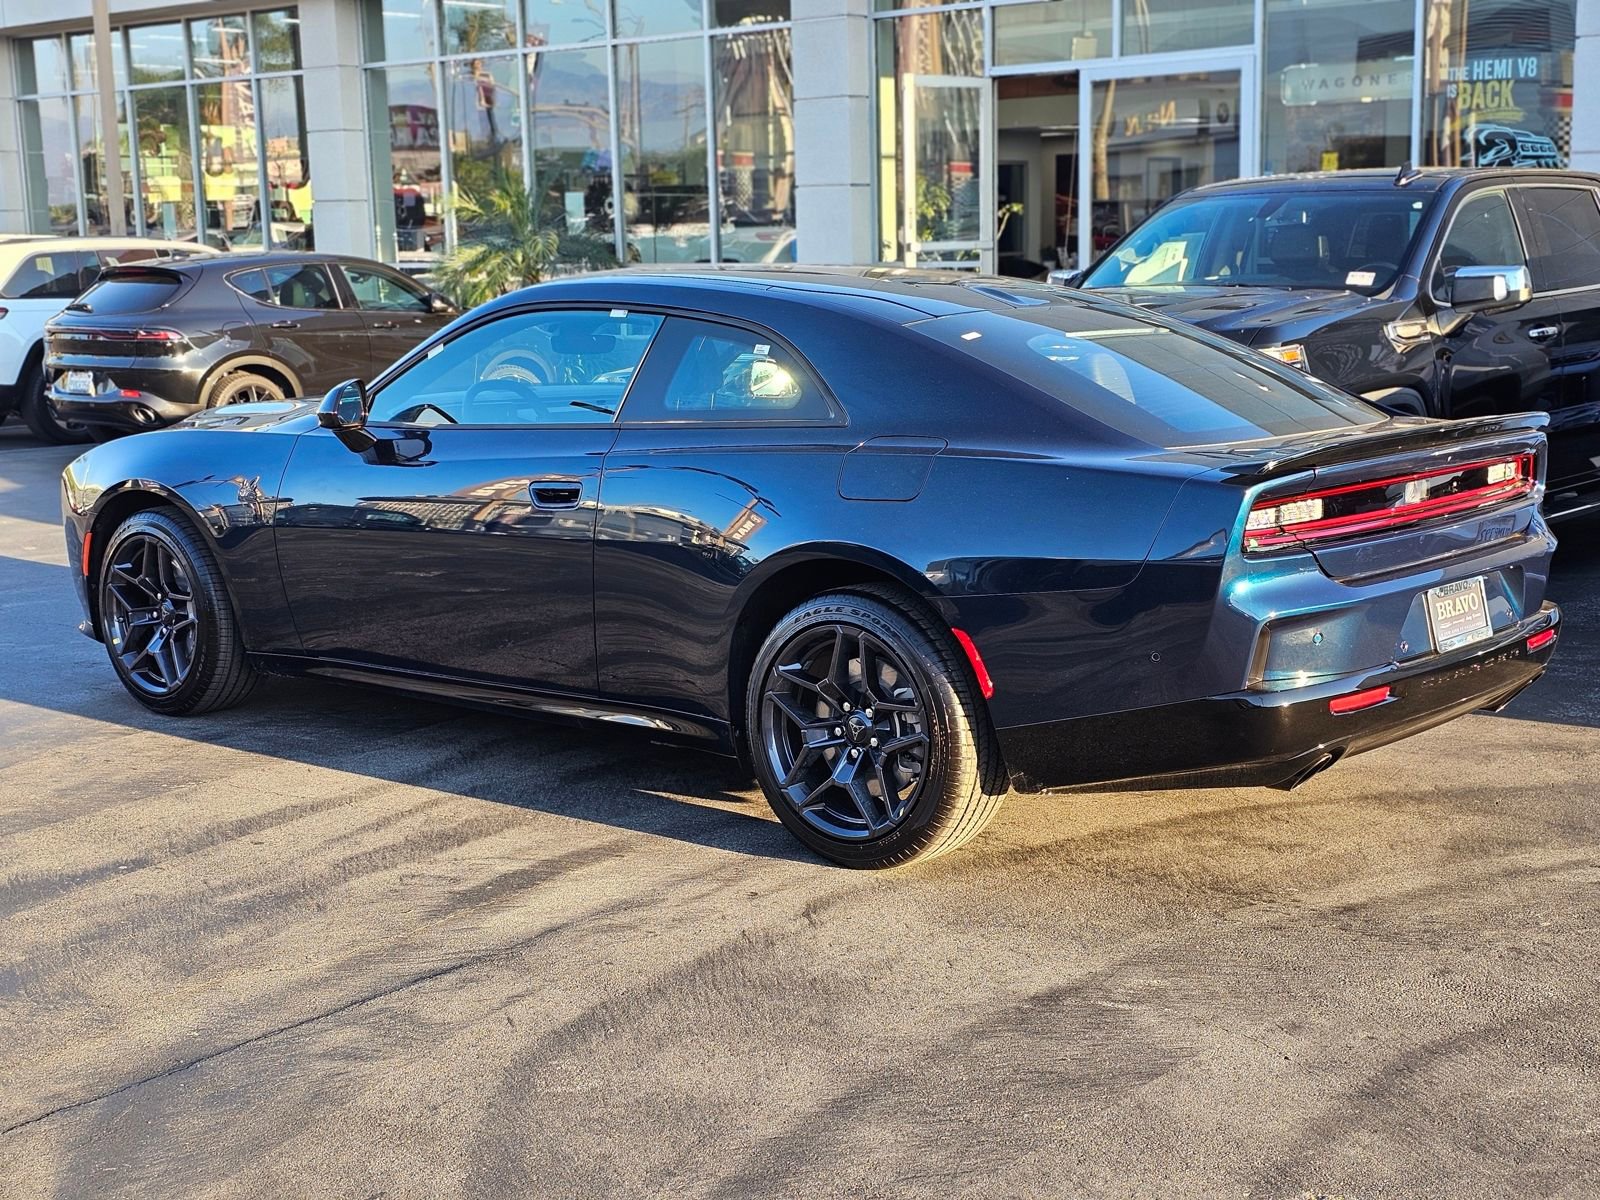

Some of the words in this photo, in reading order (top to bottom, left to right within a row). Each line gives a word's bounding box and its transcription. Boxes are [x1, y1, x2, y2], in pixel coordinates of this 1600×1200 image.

[1449, 66, 1469, 81] THE
[1472, 58, 1513, 80] HEMI
[1517, 56, 1538, 78] V8
[1447, 83, 1458, 98] IS
[1458, 79, 1515, 110] BACK
[1443, 580, 1468, 595] BRAVO
[794, 606, 845, 624] EAGLE
[1436, 592, 1479, 621] BRAVO
